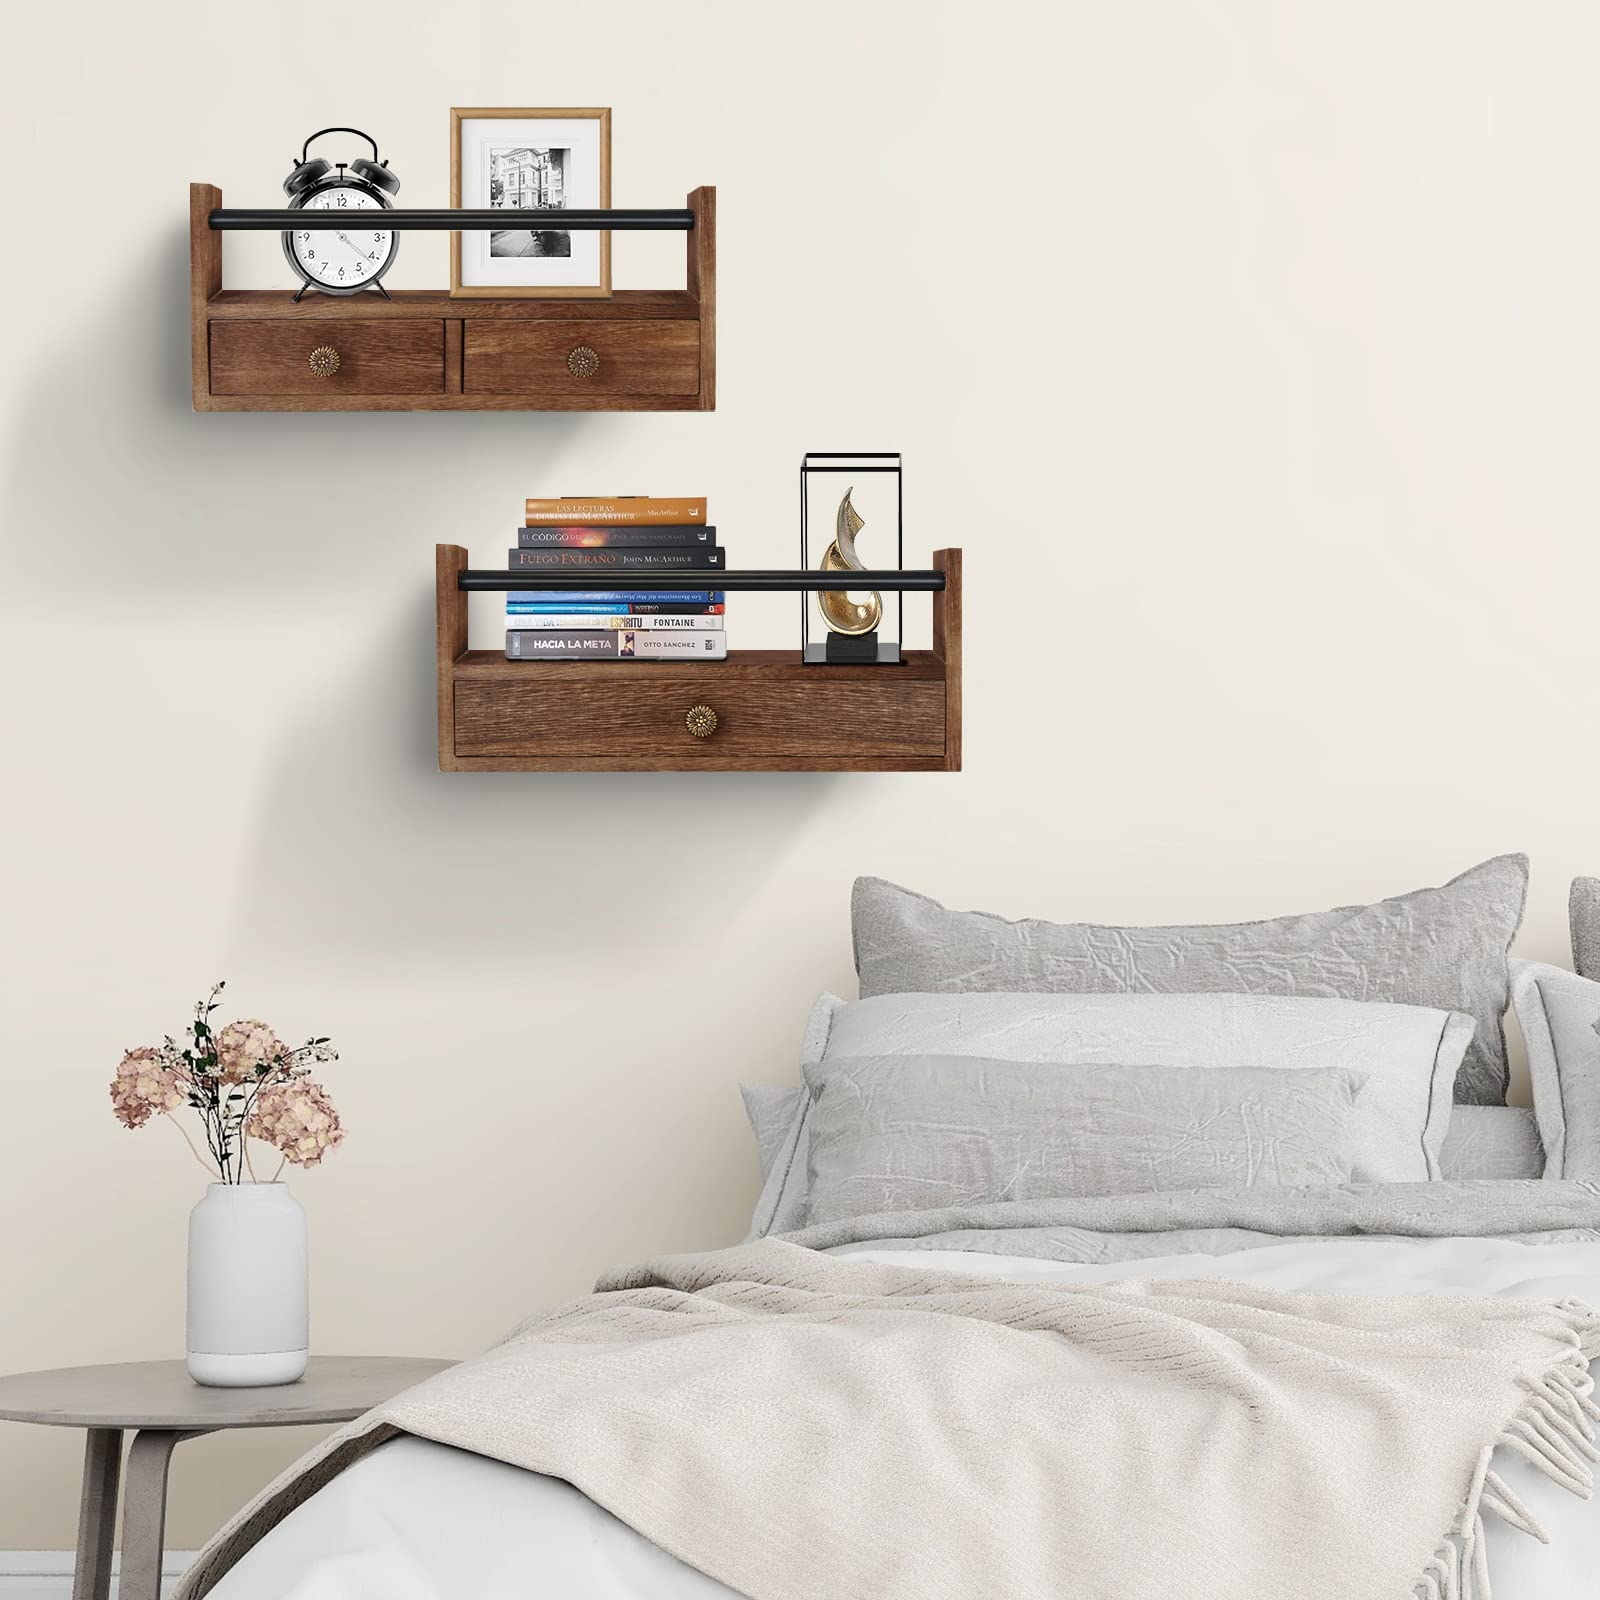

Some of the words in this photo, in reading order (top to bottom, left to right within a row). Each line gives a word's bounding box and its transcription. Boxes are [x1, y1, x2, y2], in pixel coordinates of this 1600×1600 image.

[337, 198, 347, 207] 12
[303, 233, 310, 241] 9
[374, 233, 380, 242] 3
[308, 250, 314, 259] 8
[369, 251, 375, 260] 4
[322, 262, 328, 271] 7
[355, 263, 362, 271] 5
[338, 267, 344, 276] 6
[532, 533, 569, 541] CÓDIGO
[520, 554, 558, 564] FUEGO
[562, 554, 616, 564] EXTRAÑO
[610, 617, 642, 627] ESPÍRITU
[534, 640, 564, 648] HACIA
[568, 640, 581, 648] LA
[584, 640, 611, 648] META
